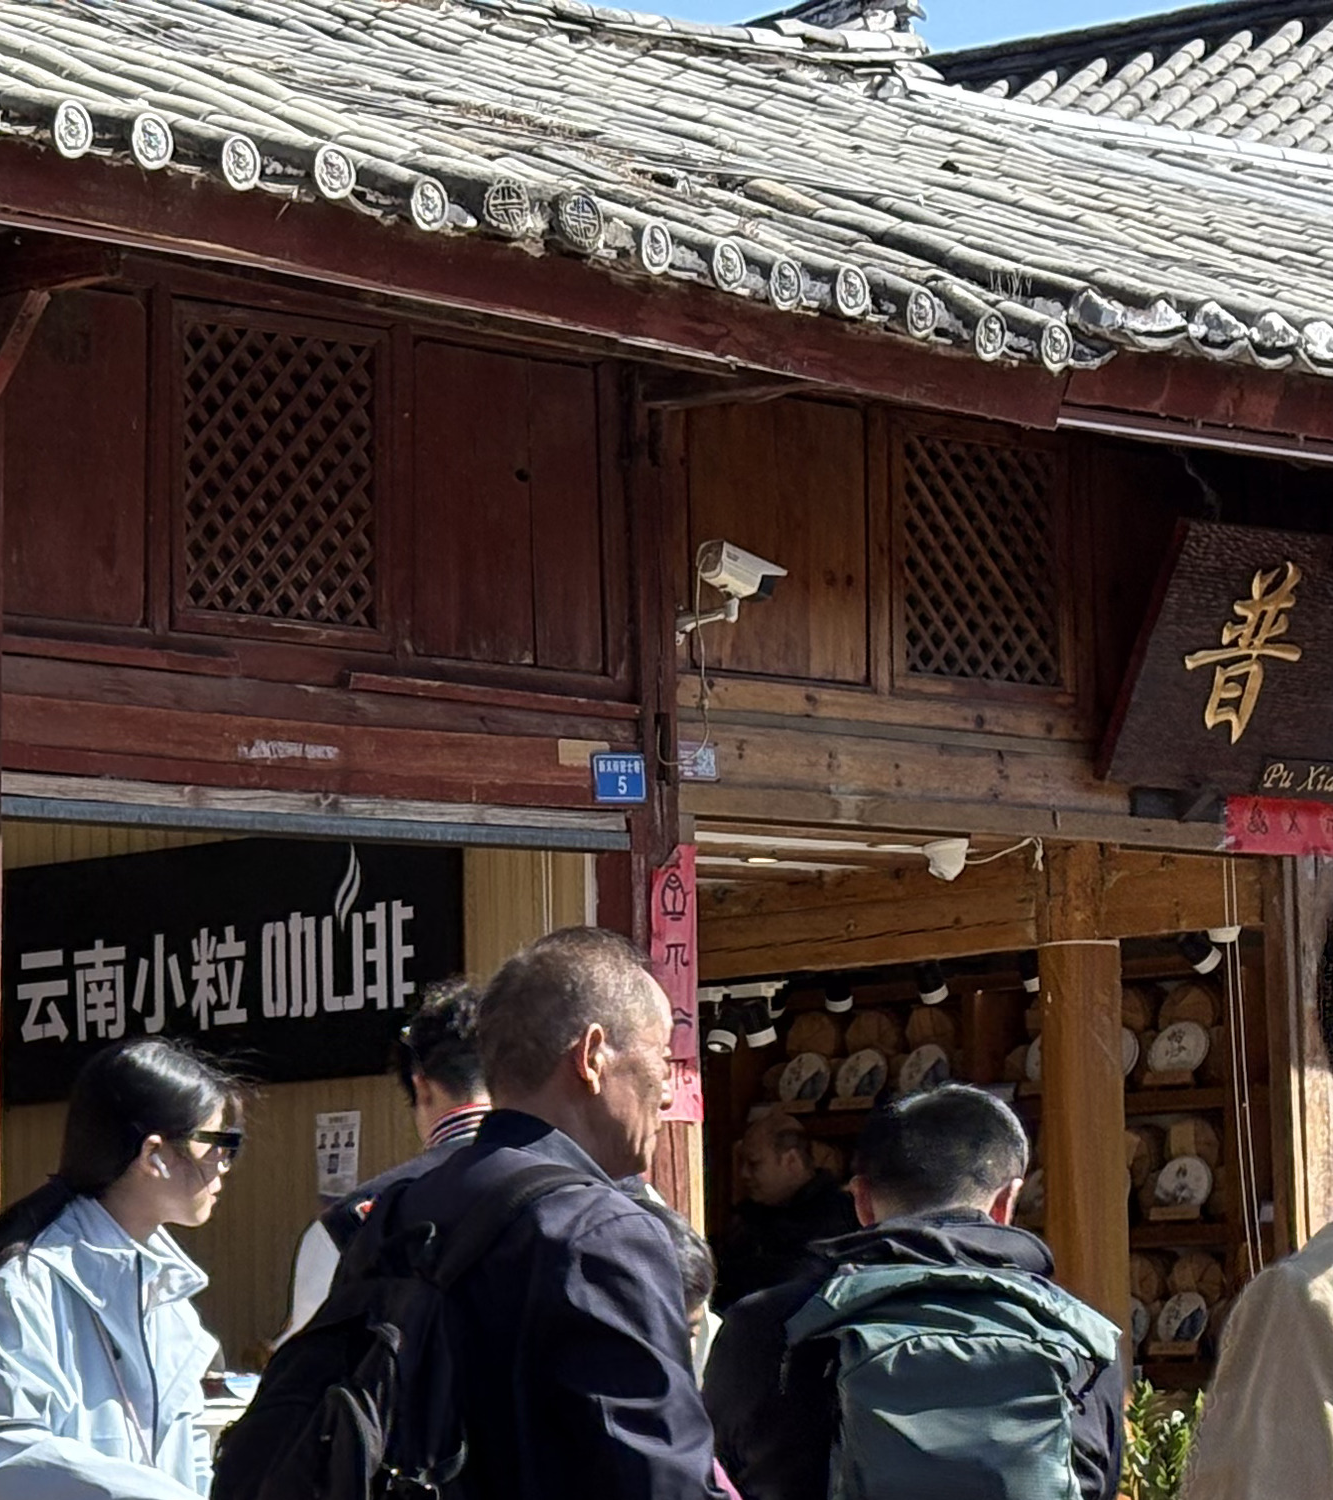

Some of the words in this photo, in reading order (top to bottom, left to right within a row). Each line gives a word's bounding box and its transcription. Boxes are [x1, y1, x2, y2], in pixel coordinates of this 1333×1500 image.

[1184, 561, 1303, 745] 普
[617, 776, 628, 795] 5
[1263, 763, 1294, 788] Pu
[16, 885, 416, 1043] 云南小粒咖啡
